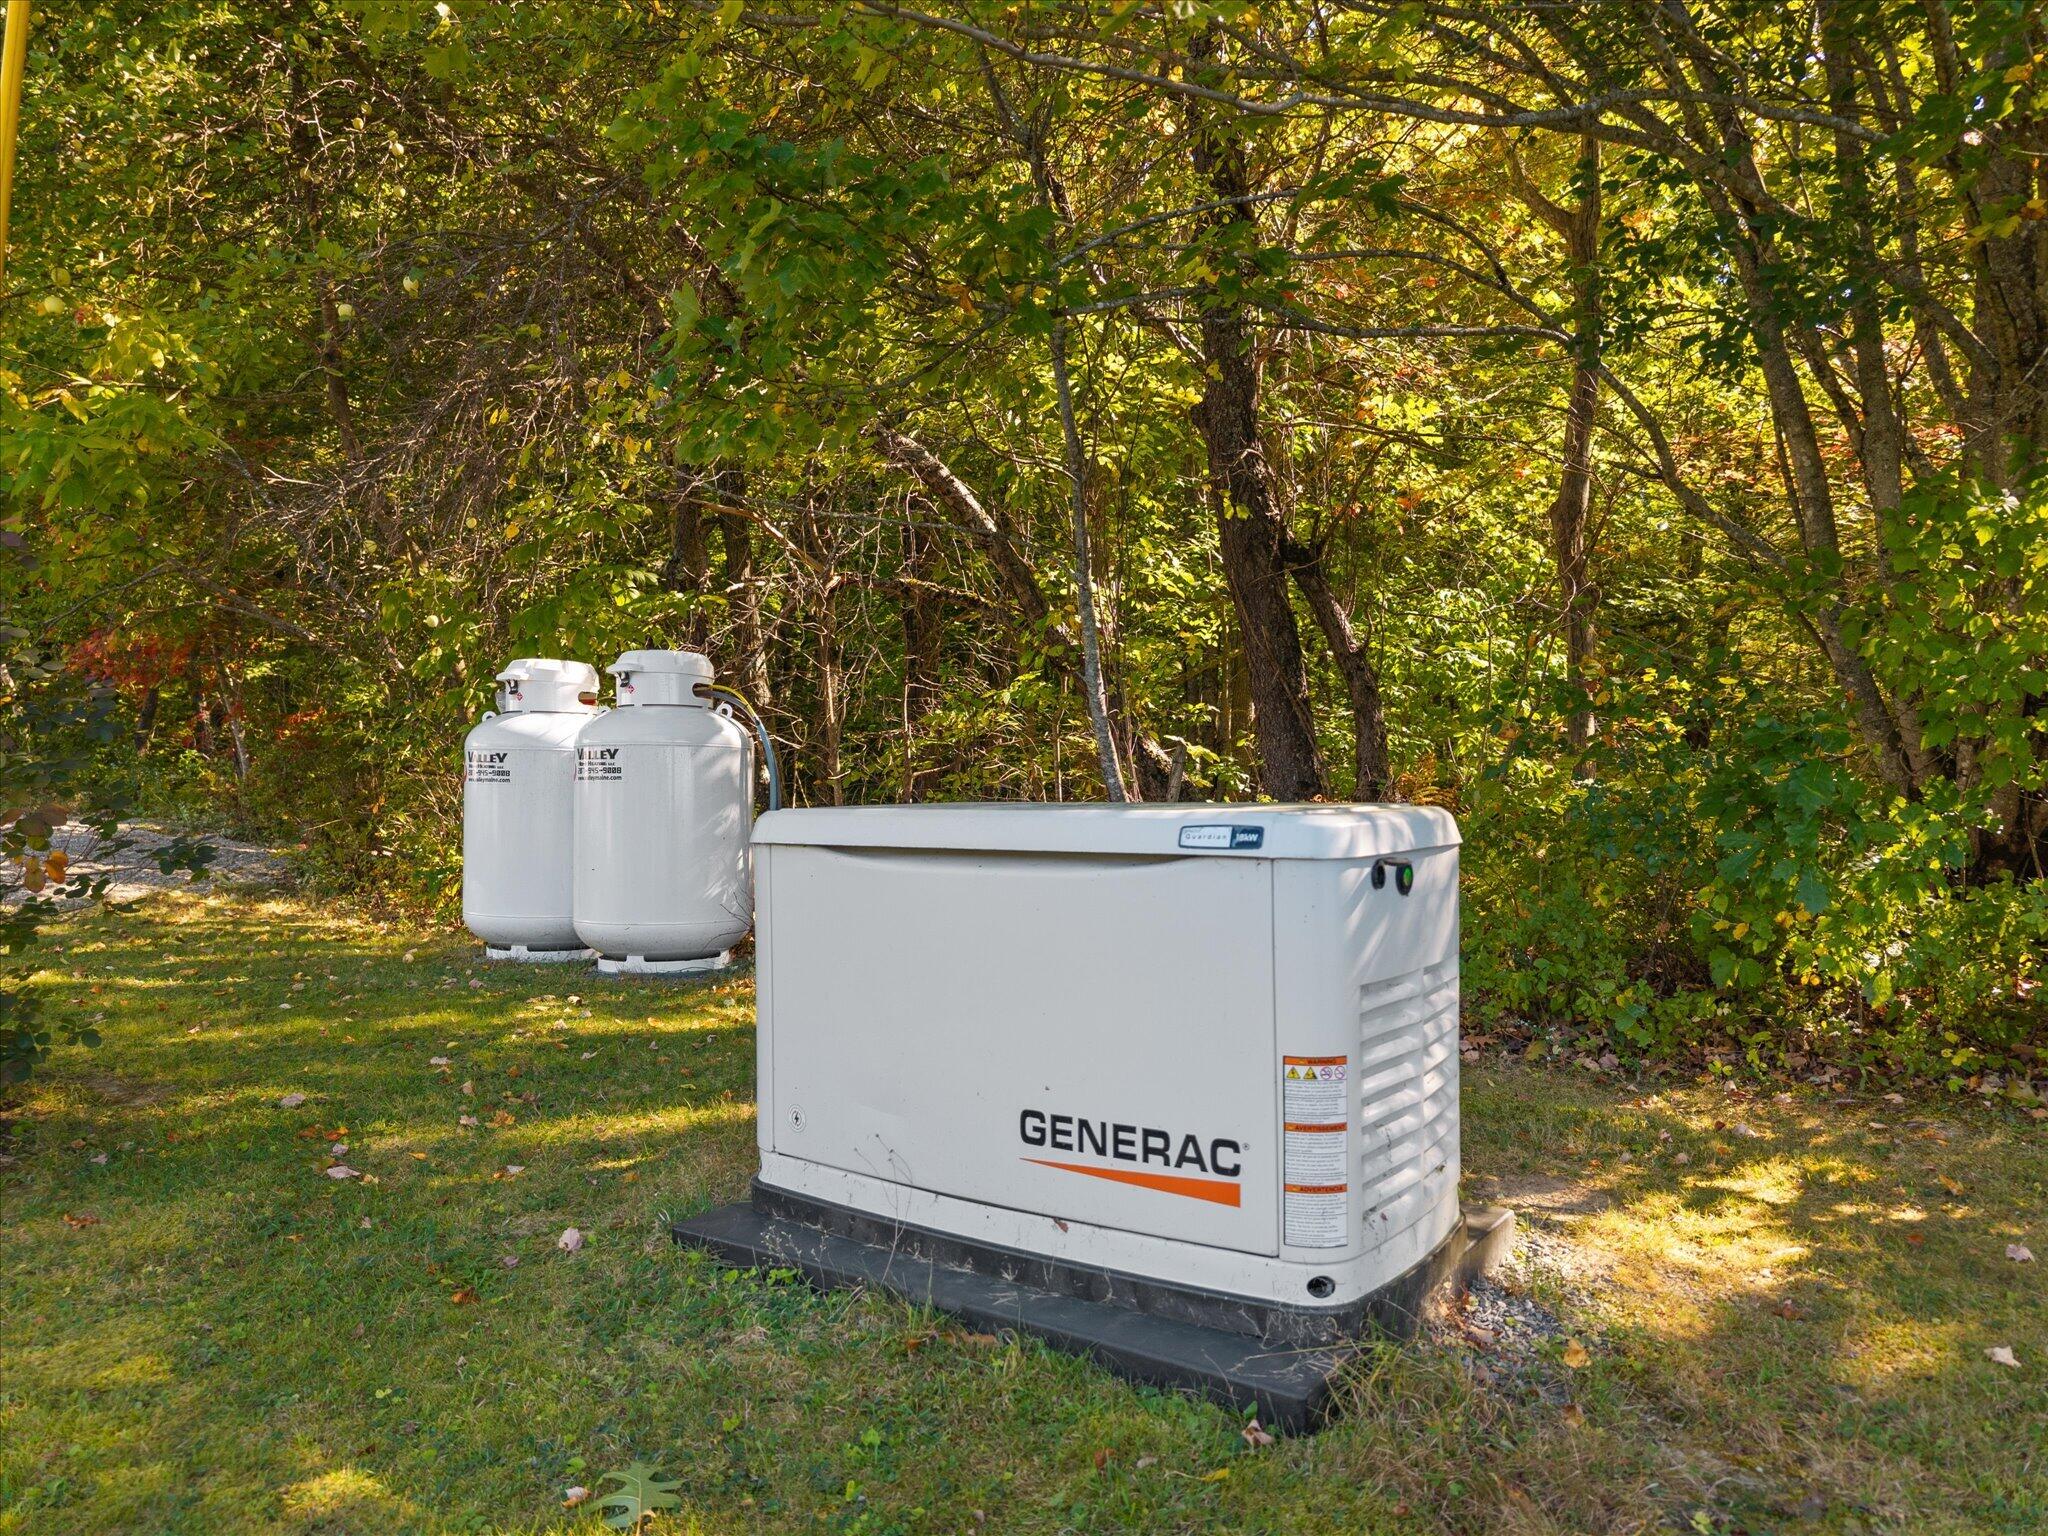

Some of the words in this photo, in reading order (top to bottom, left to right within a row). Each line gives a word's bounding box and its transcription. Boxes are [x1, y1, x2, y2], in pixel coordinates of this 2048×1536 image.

[468, 751, 508, 763] VLLEY
[577, 748, 619, 760] VLLEY
[1185, 832, 1227, 840] Guardian
[1020, 1109, 1241, 1177] GENERAC
